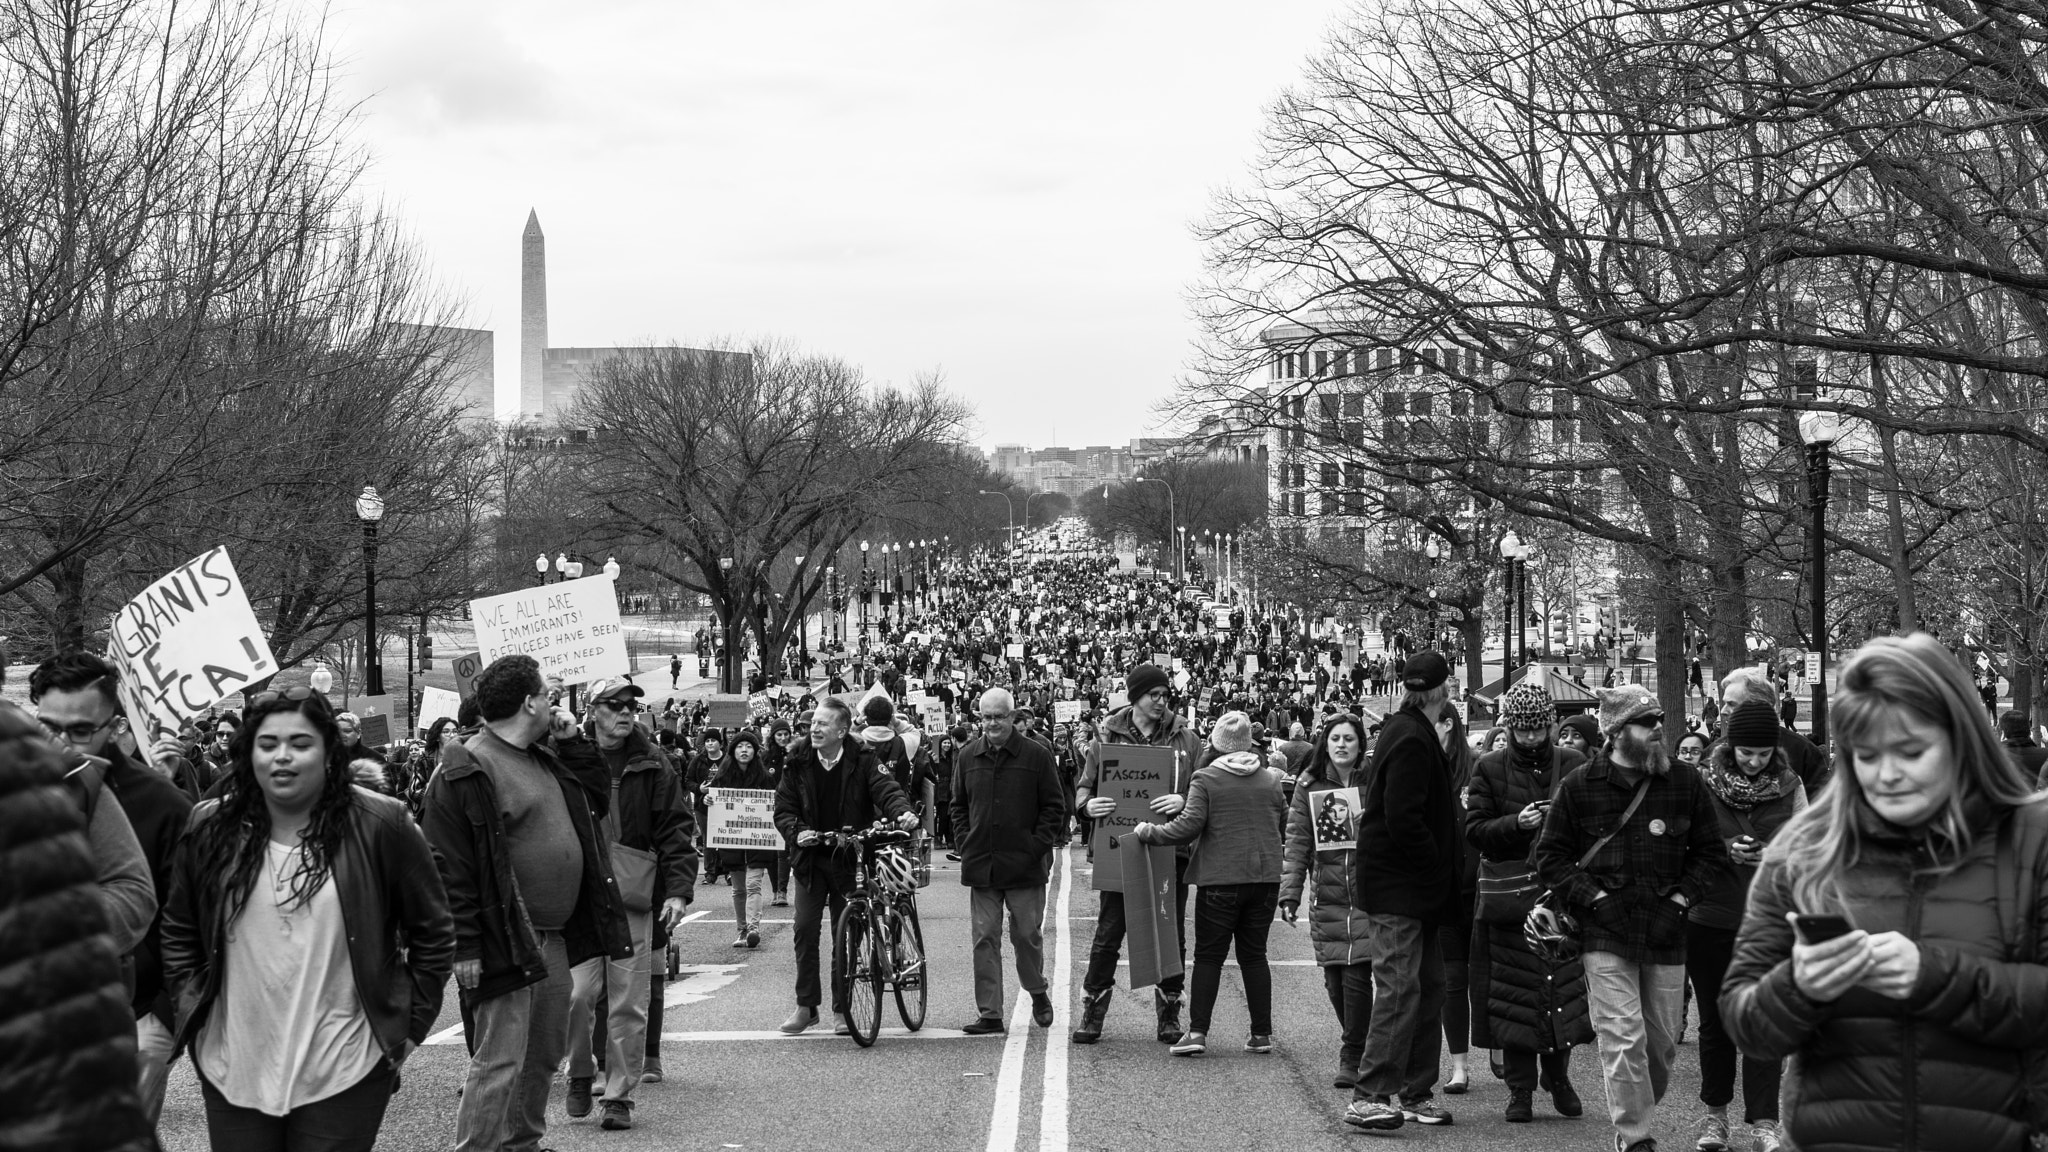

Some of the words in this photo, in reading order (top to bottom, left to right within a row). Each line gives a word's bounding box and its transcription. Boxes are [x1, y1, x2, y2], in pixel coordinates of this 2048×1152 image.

[479, 604, 509, 629] WE
[516, 600, 540, 619] ALL
[548, 592, 574, 610] ARE
[501, 610, 583, 642] IMMIGRANTS!
[556, 630, 585, 644] HAVE
[592, 622, 620, 637] BEEN
[543, 652, 568, 667] THEY
[574, 647, 605, 659] NEED
[927, 722, 943, 733] ACLU
[1102, 760, 1160, 783] FASCISM
[1123, 789, 1131, 799] IS
[1135, 789, 1149, 799] AS
